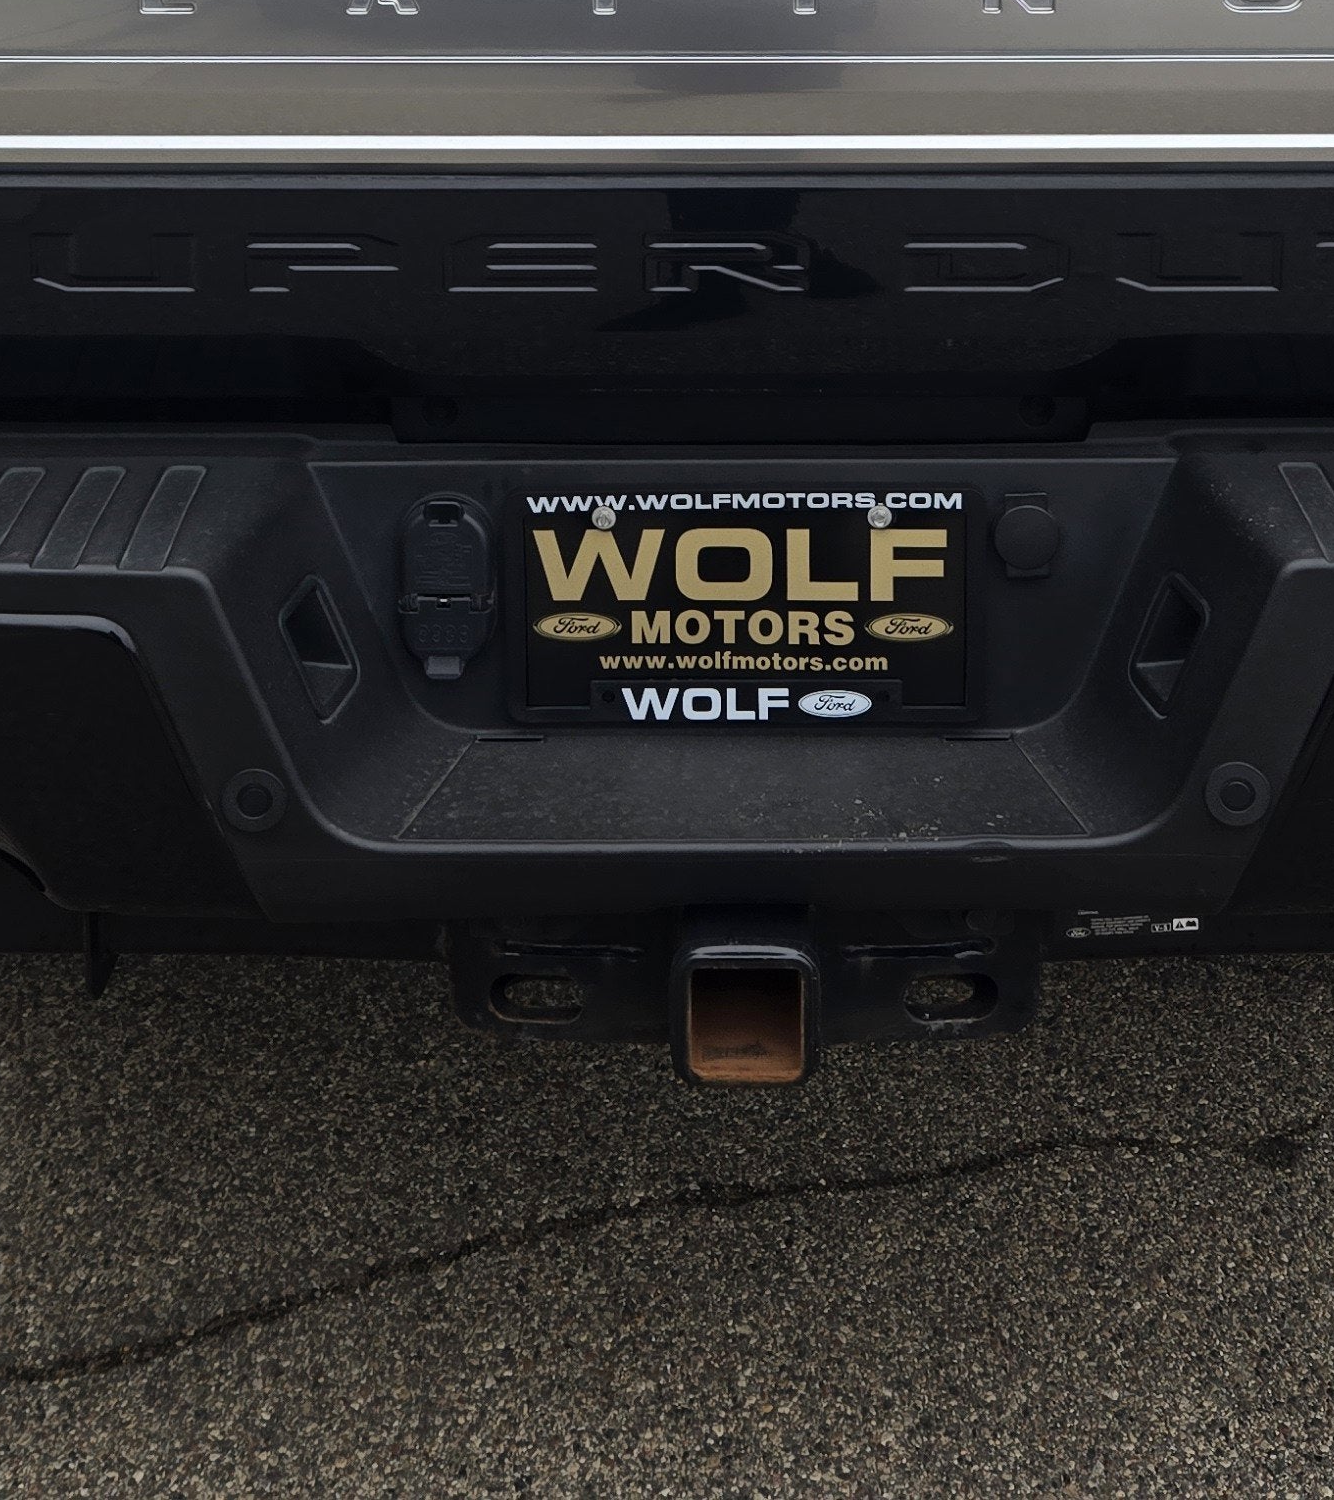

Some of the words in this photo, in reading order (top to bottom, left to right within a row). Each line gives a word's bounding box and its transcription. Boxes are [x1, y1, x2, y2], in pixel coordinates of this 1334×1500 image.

[526, 492, 963, 513] WWW.WOLFMOTORS.COM
[532, 528, 948, 602] WOLF
[553, 617, 601, 634] Ford
[630, 610, 856, 645] MOTORS
[884, 617, 933, 635] Ford
[599, 651, 889, 671] www.wolfmotors.com
[621, 687, 790, 720] WOLF
[814, 694, 857, 712] Ford
